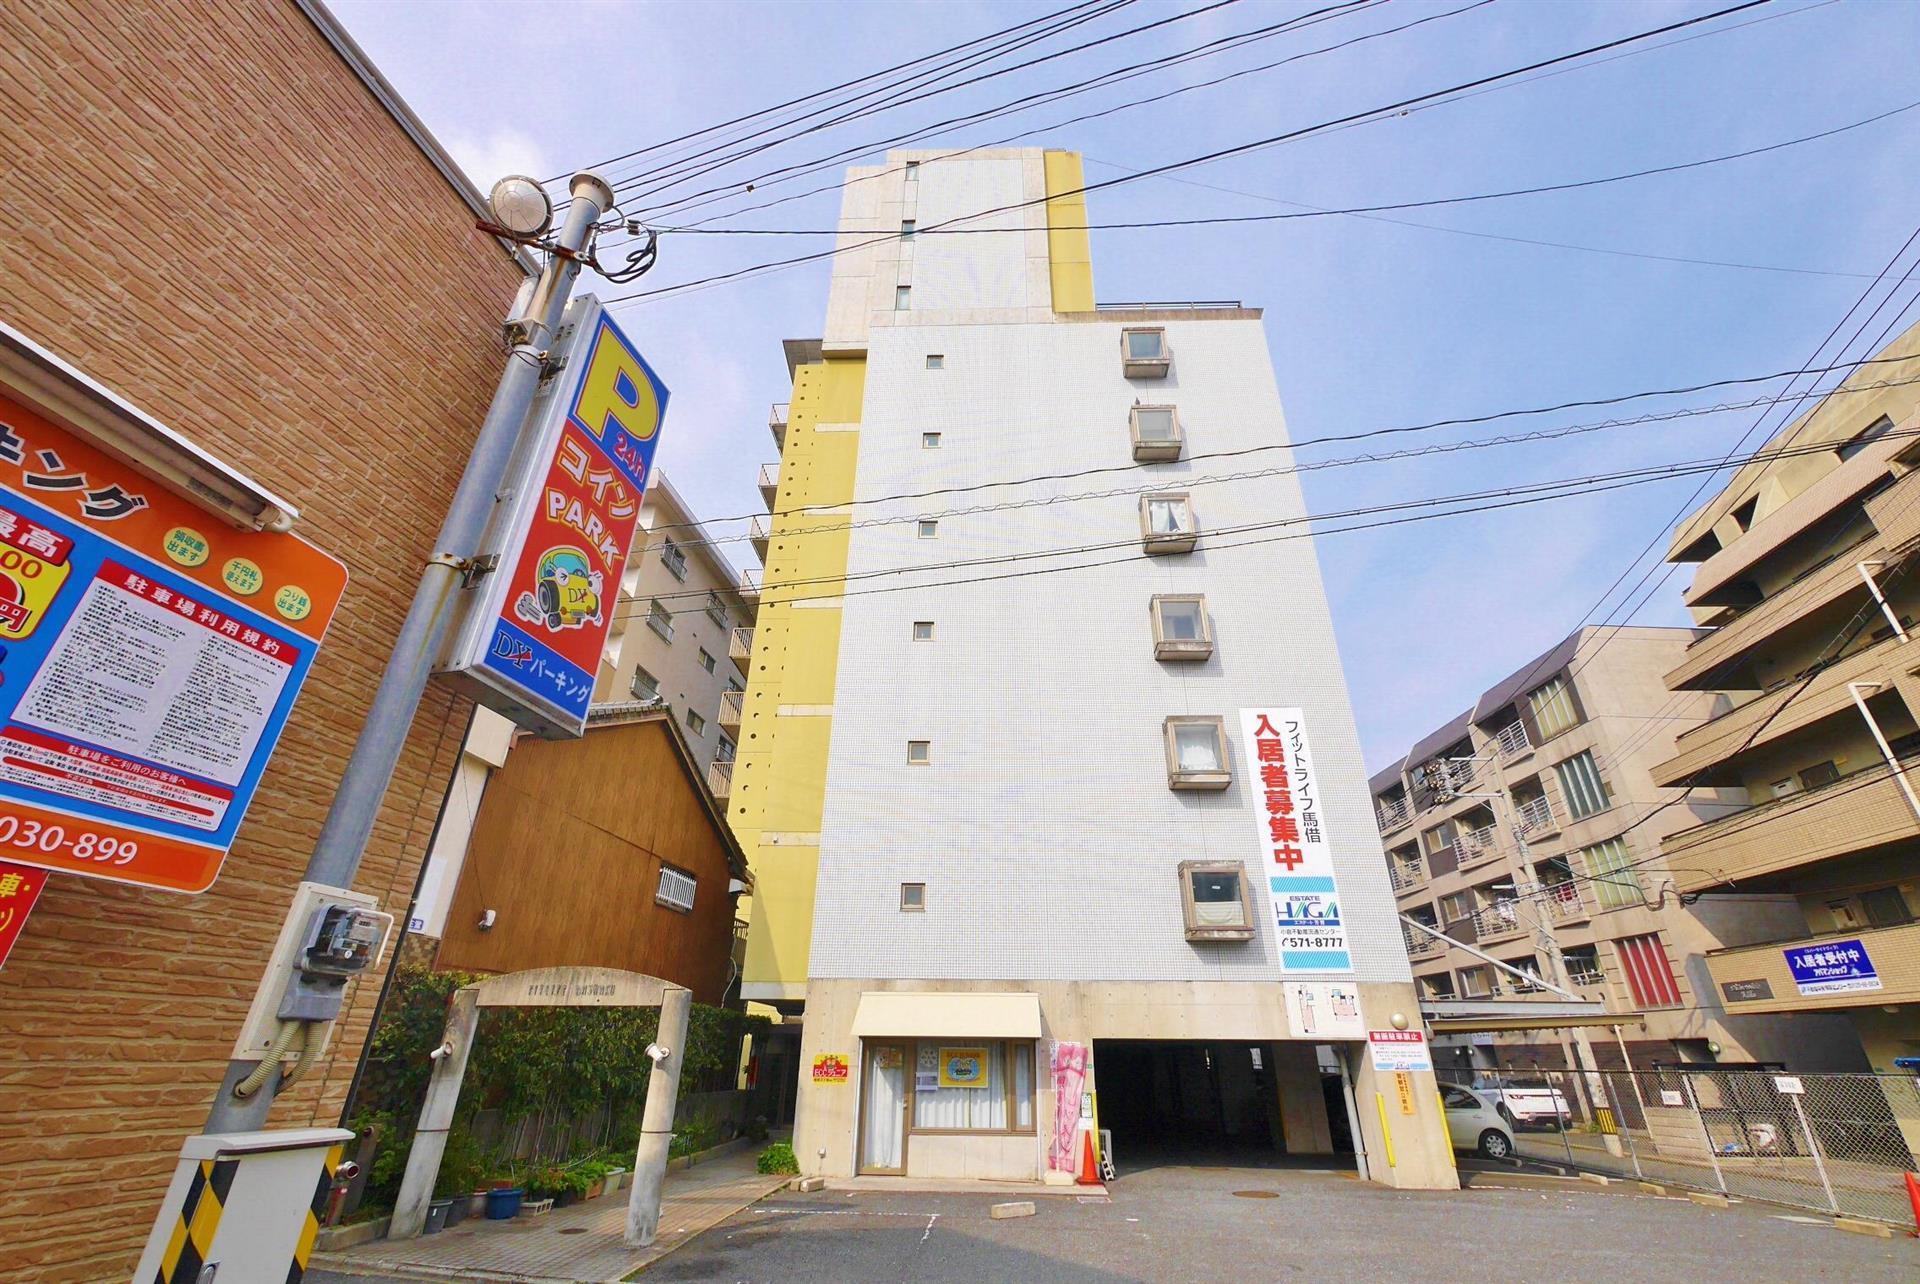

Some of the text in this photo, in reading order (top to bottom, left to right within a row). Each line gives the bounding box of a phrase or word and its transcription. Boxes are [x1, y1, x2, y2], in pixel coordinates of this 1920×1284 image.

[574, 320, 660, 442] P
[558, 435, 636, 519] コイン
[613, 433, 645, 483] 24h
[546, 488, 624, 575] PARK
[232, 560, 258, 582] 千円札
[124, 573, 281, 655] 駐車場利用規約
[67, 744, 187, 786] 駐車場をご利用のお客様へ
[1254, 714, 1304, 871] 入居者募集中
[1285, 721, 1321, 843] フィットライフ馬借
[1275, 902, 1339, 918] HAGA
[1290, 937, 1343, 948] 571-8777
[1794, 948, 1860, 969] 入居者受付中
